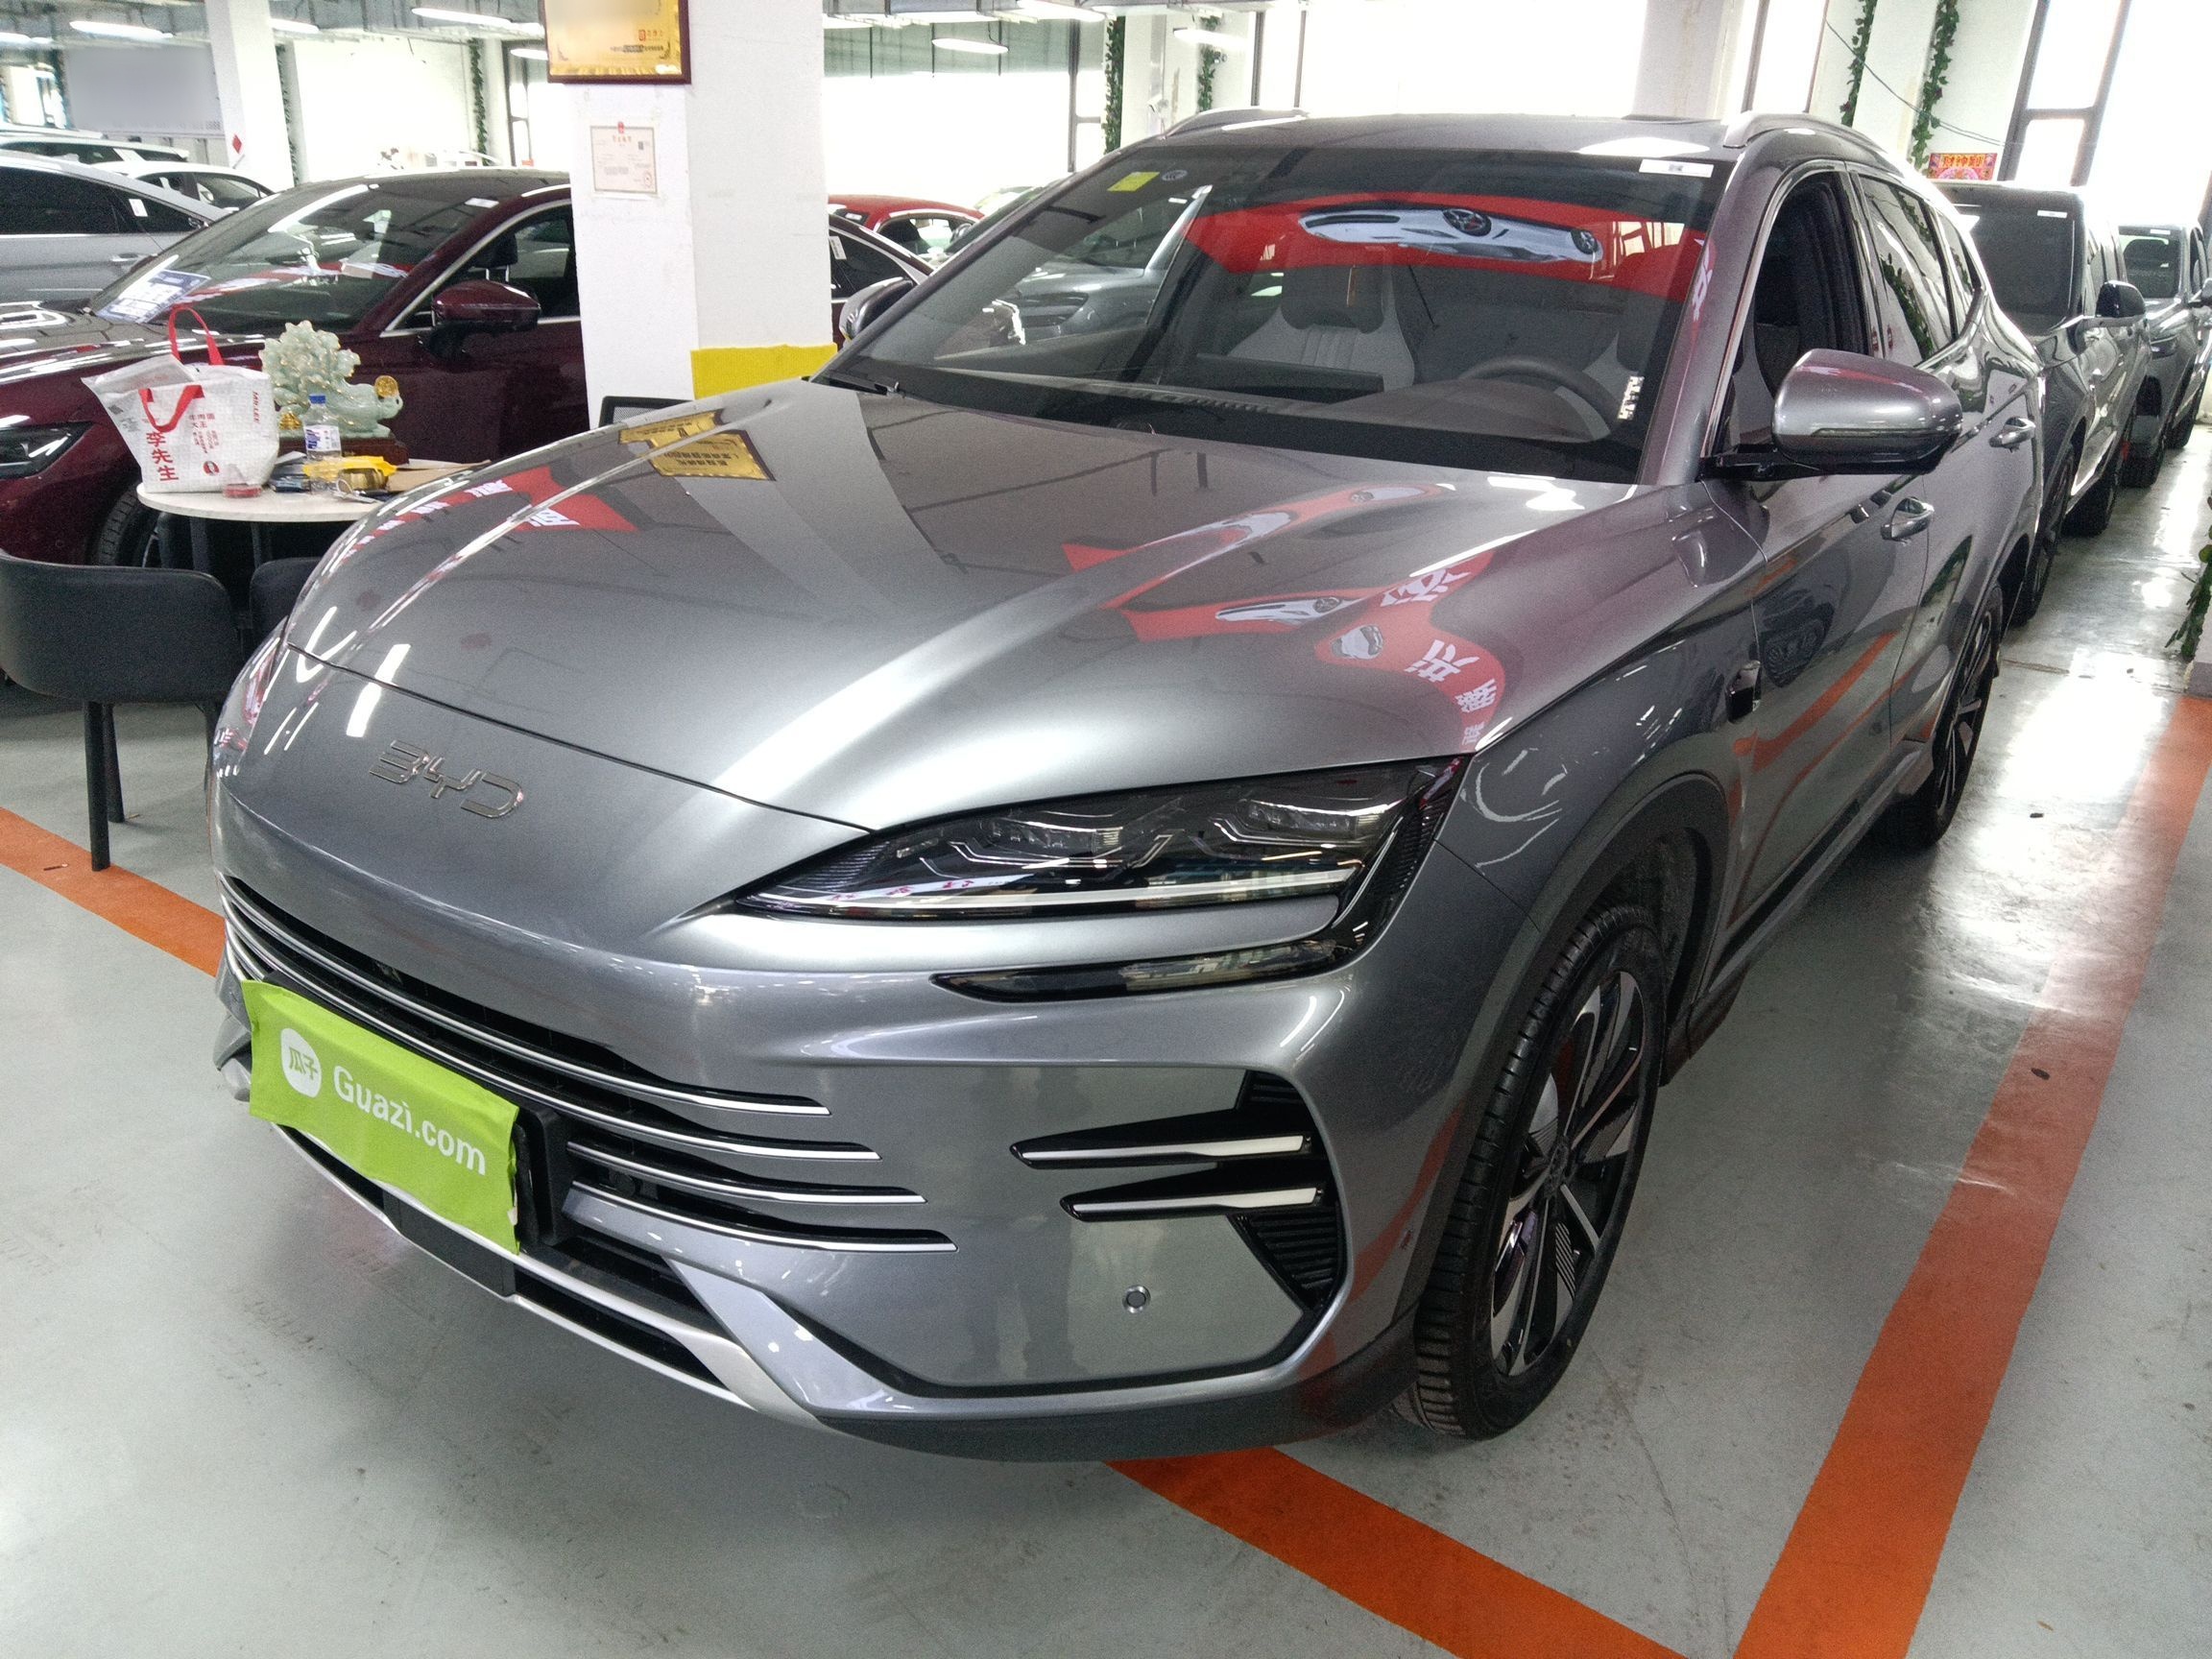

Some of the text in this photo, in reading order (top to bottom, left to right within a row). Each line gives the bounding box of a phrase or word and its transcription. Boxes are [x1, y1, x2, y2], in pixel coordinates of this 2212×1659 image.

[145, 430, 180, 482] 李先生
[369, 739, 524, 818] BYD
[288, 1046, 319, 1081] 瓜子
[333, 1065, 487, 1176] Guazi.com
